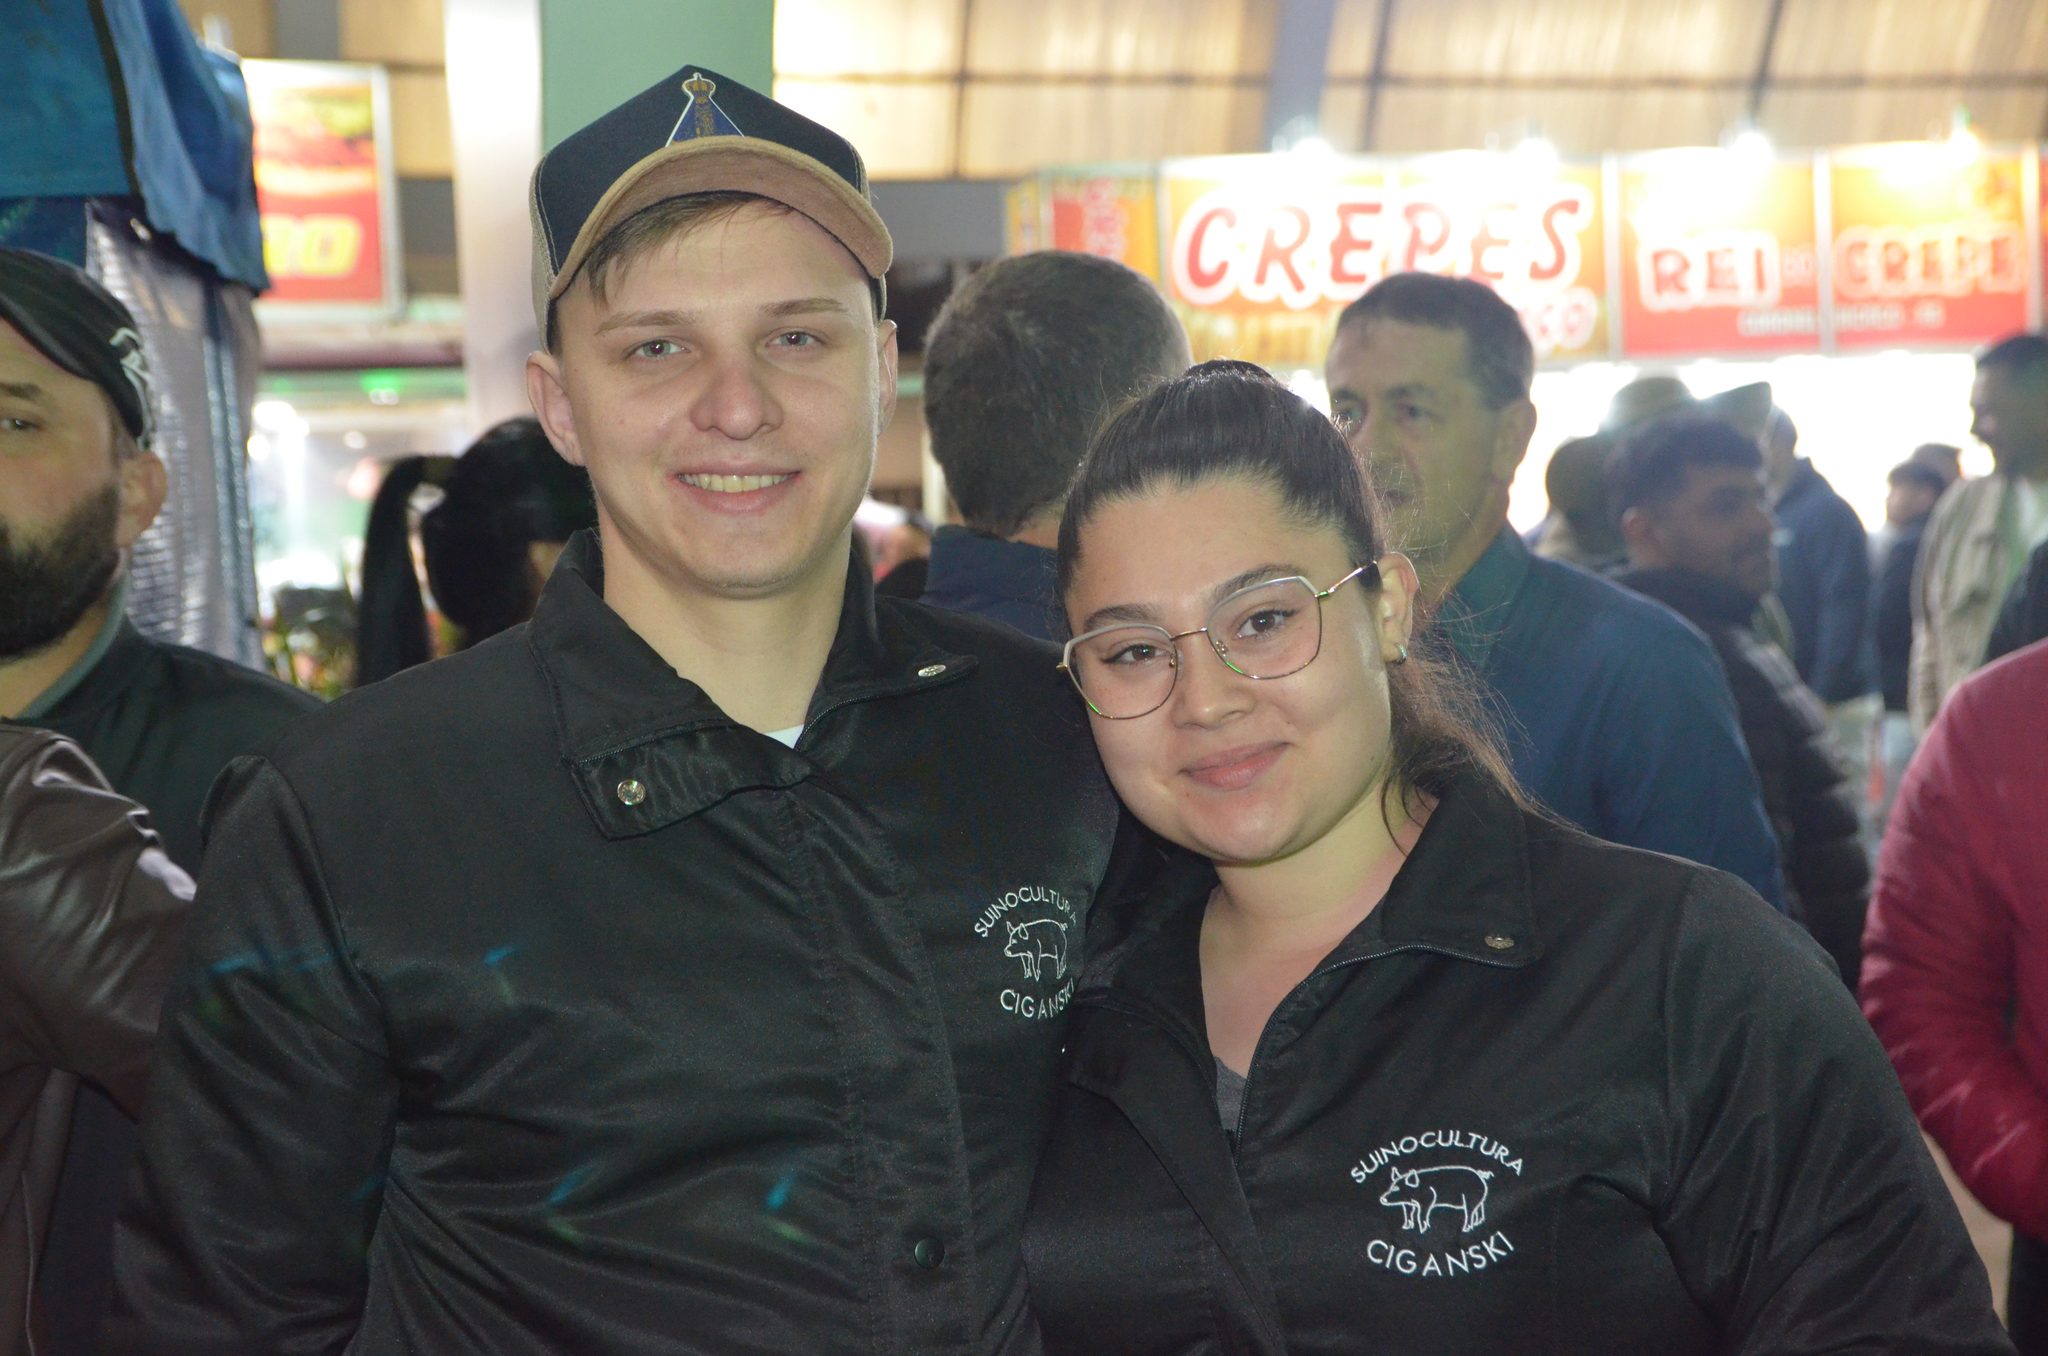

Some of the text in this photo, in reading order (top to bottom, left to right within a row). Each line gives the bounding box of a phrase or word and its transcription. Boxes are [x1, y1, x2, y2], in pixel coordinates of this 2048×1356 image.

[1184, 198, 1582, 294] CREPES
[1650, 244, 1768, 297] REI
[1844, 232, 2016, 288] CREPE
[974, 886, 1077, 938] SUINOCULTURA
[1000, 977, 1075, 1020] CIGANSKI
[1350, 1129, 1524, 1184] SUINOCULTURA
[1366, 1230, 1515, 1277] CIGANSKI
